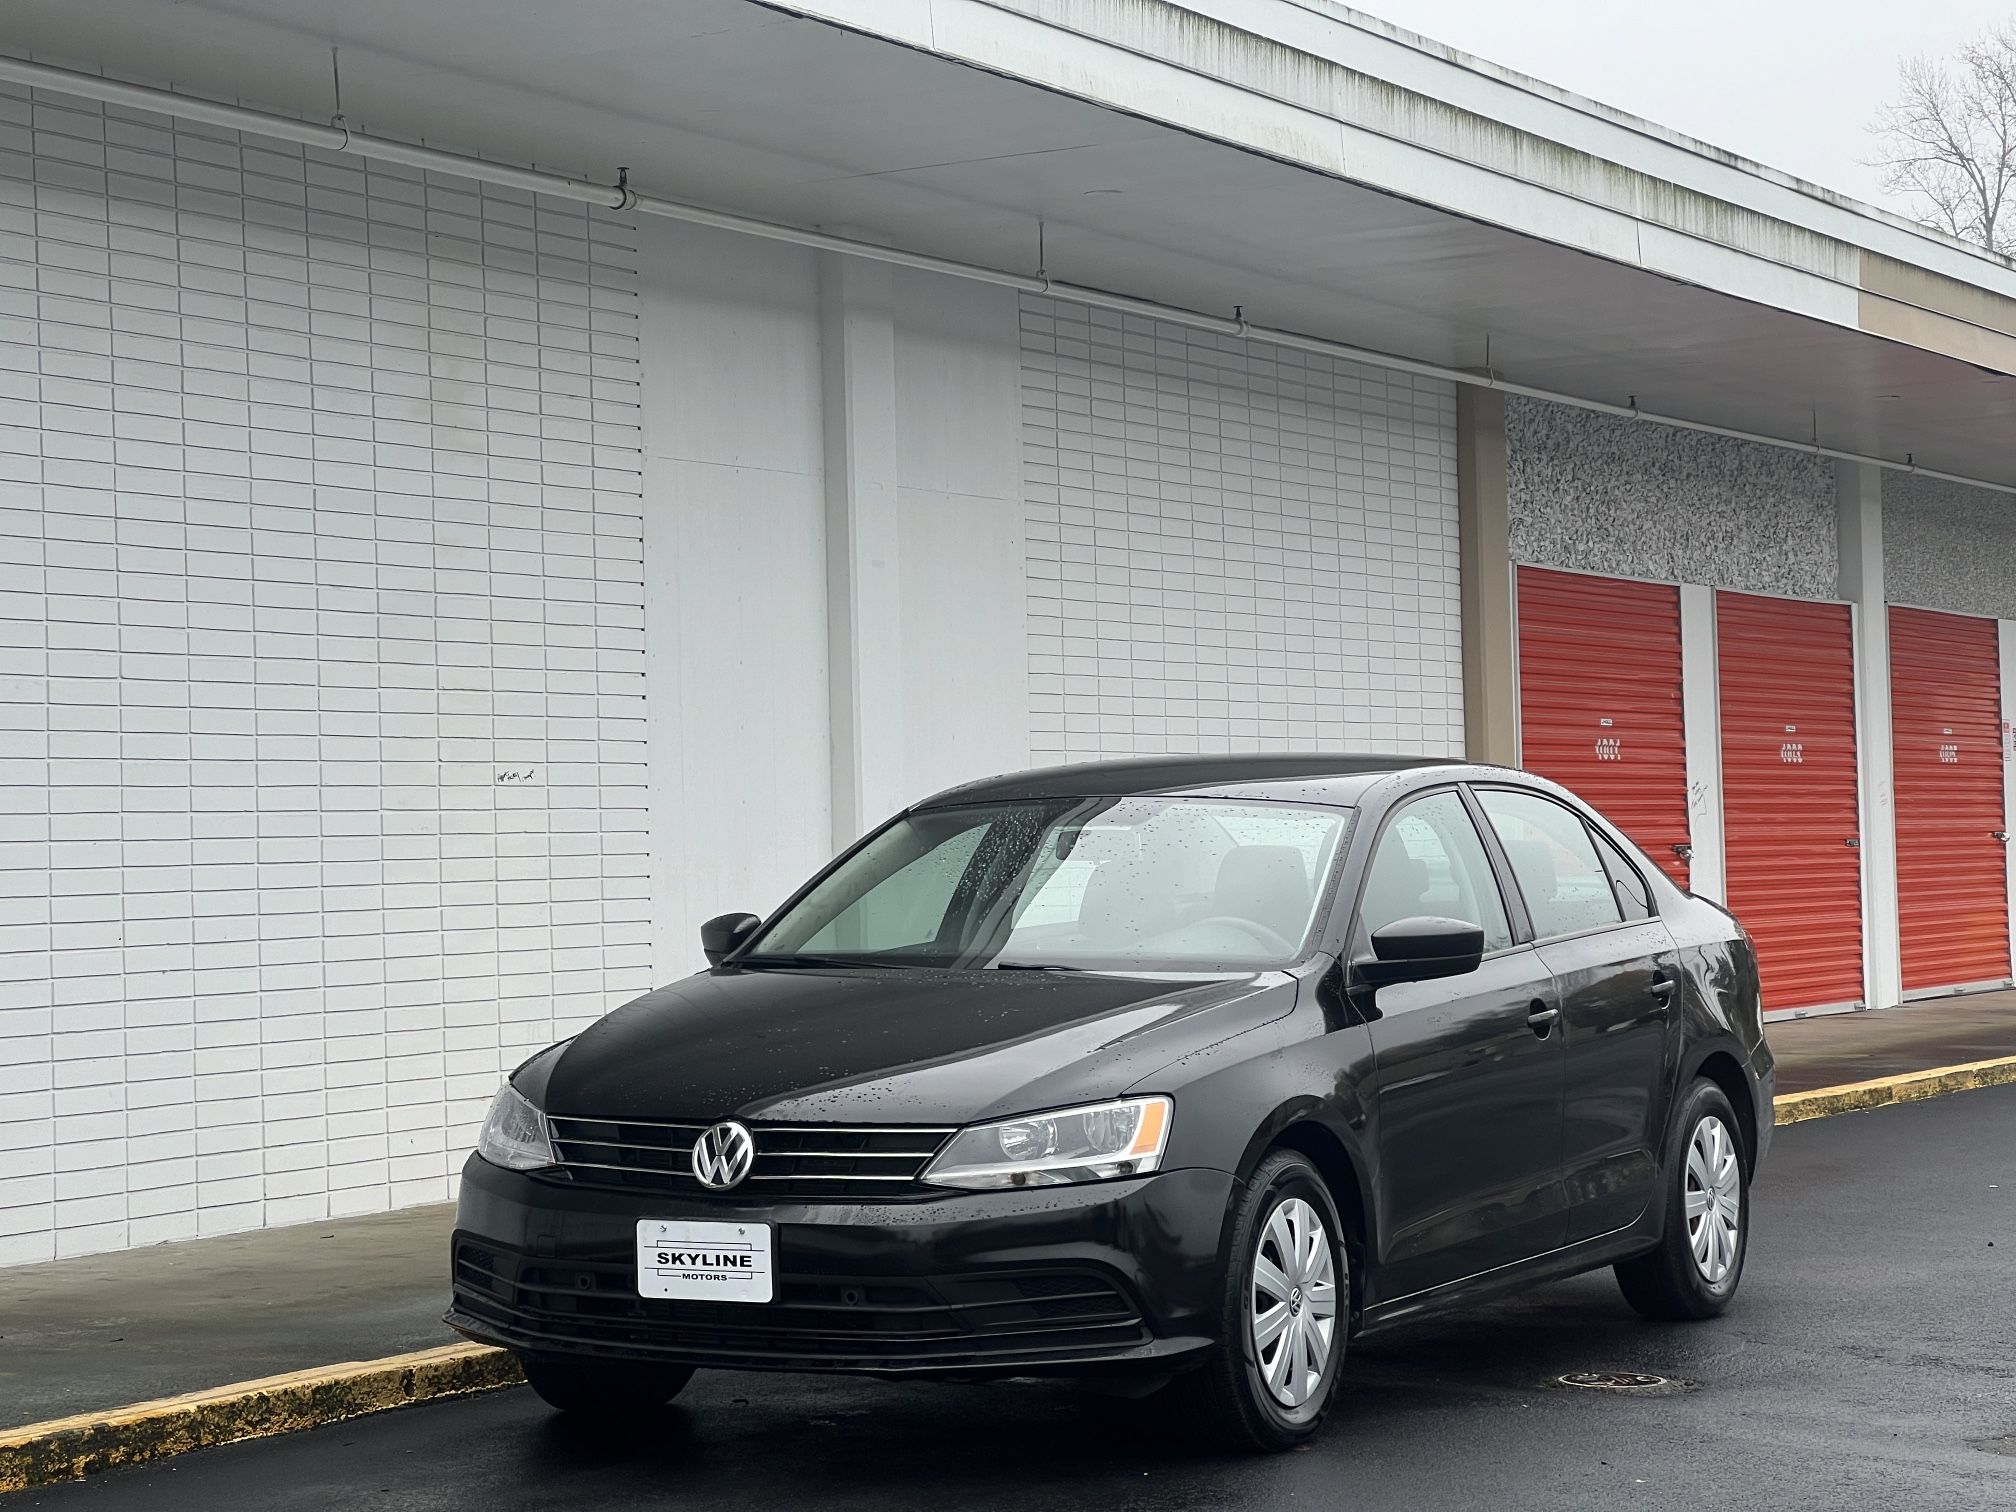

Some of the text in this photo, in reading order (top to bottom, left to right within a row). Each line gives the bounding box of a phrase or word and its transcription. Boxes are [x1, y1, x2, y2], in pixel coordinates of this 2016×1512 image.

[692, 1121, 754, 1191] VW
[656, 1252, 753, 1268] SKYLINE
[682, 1273, 728, 1282] MOTORS
